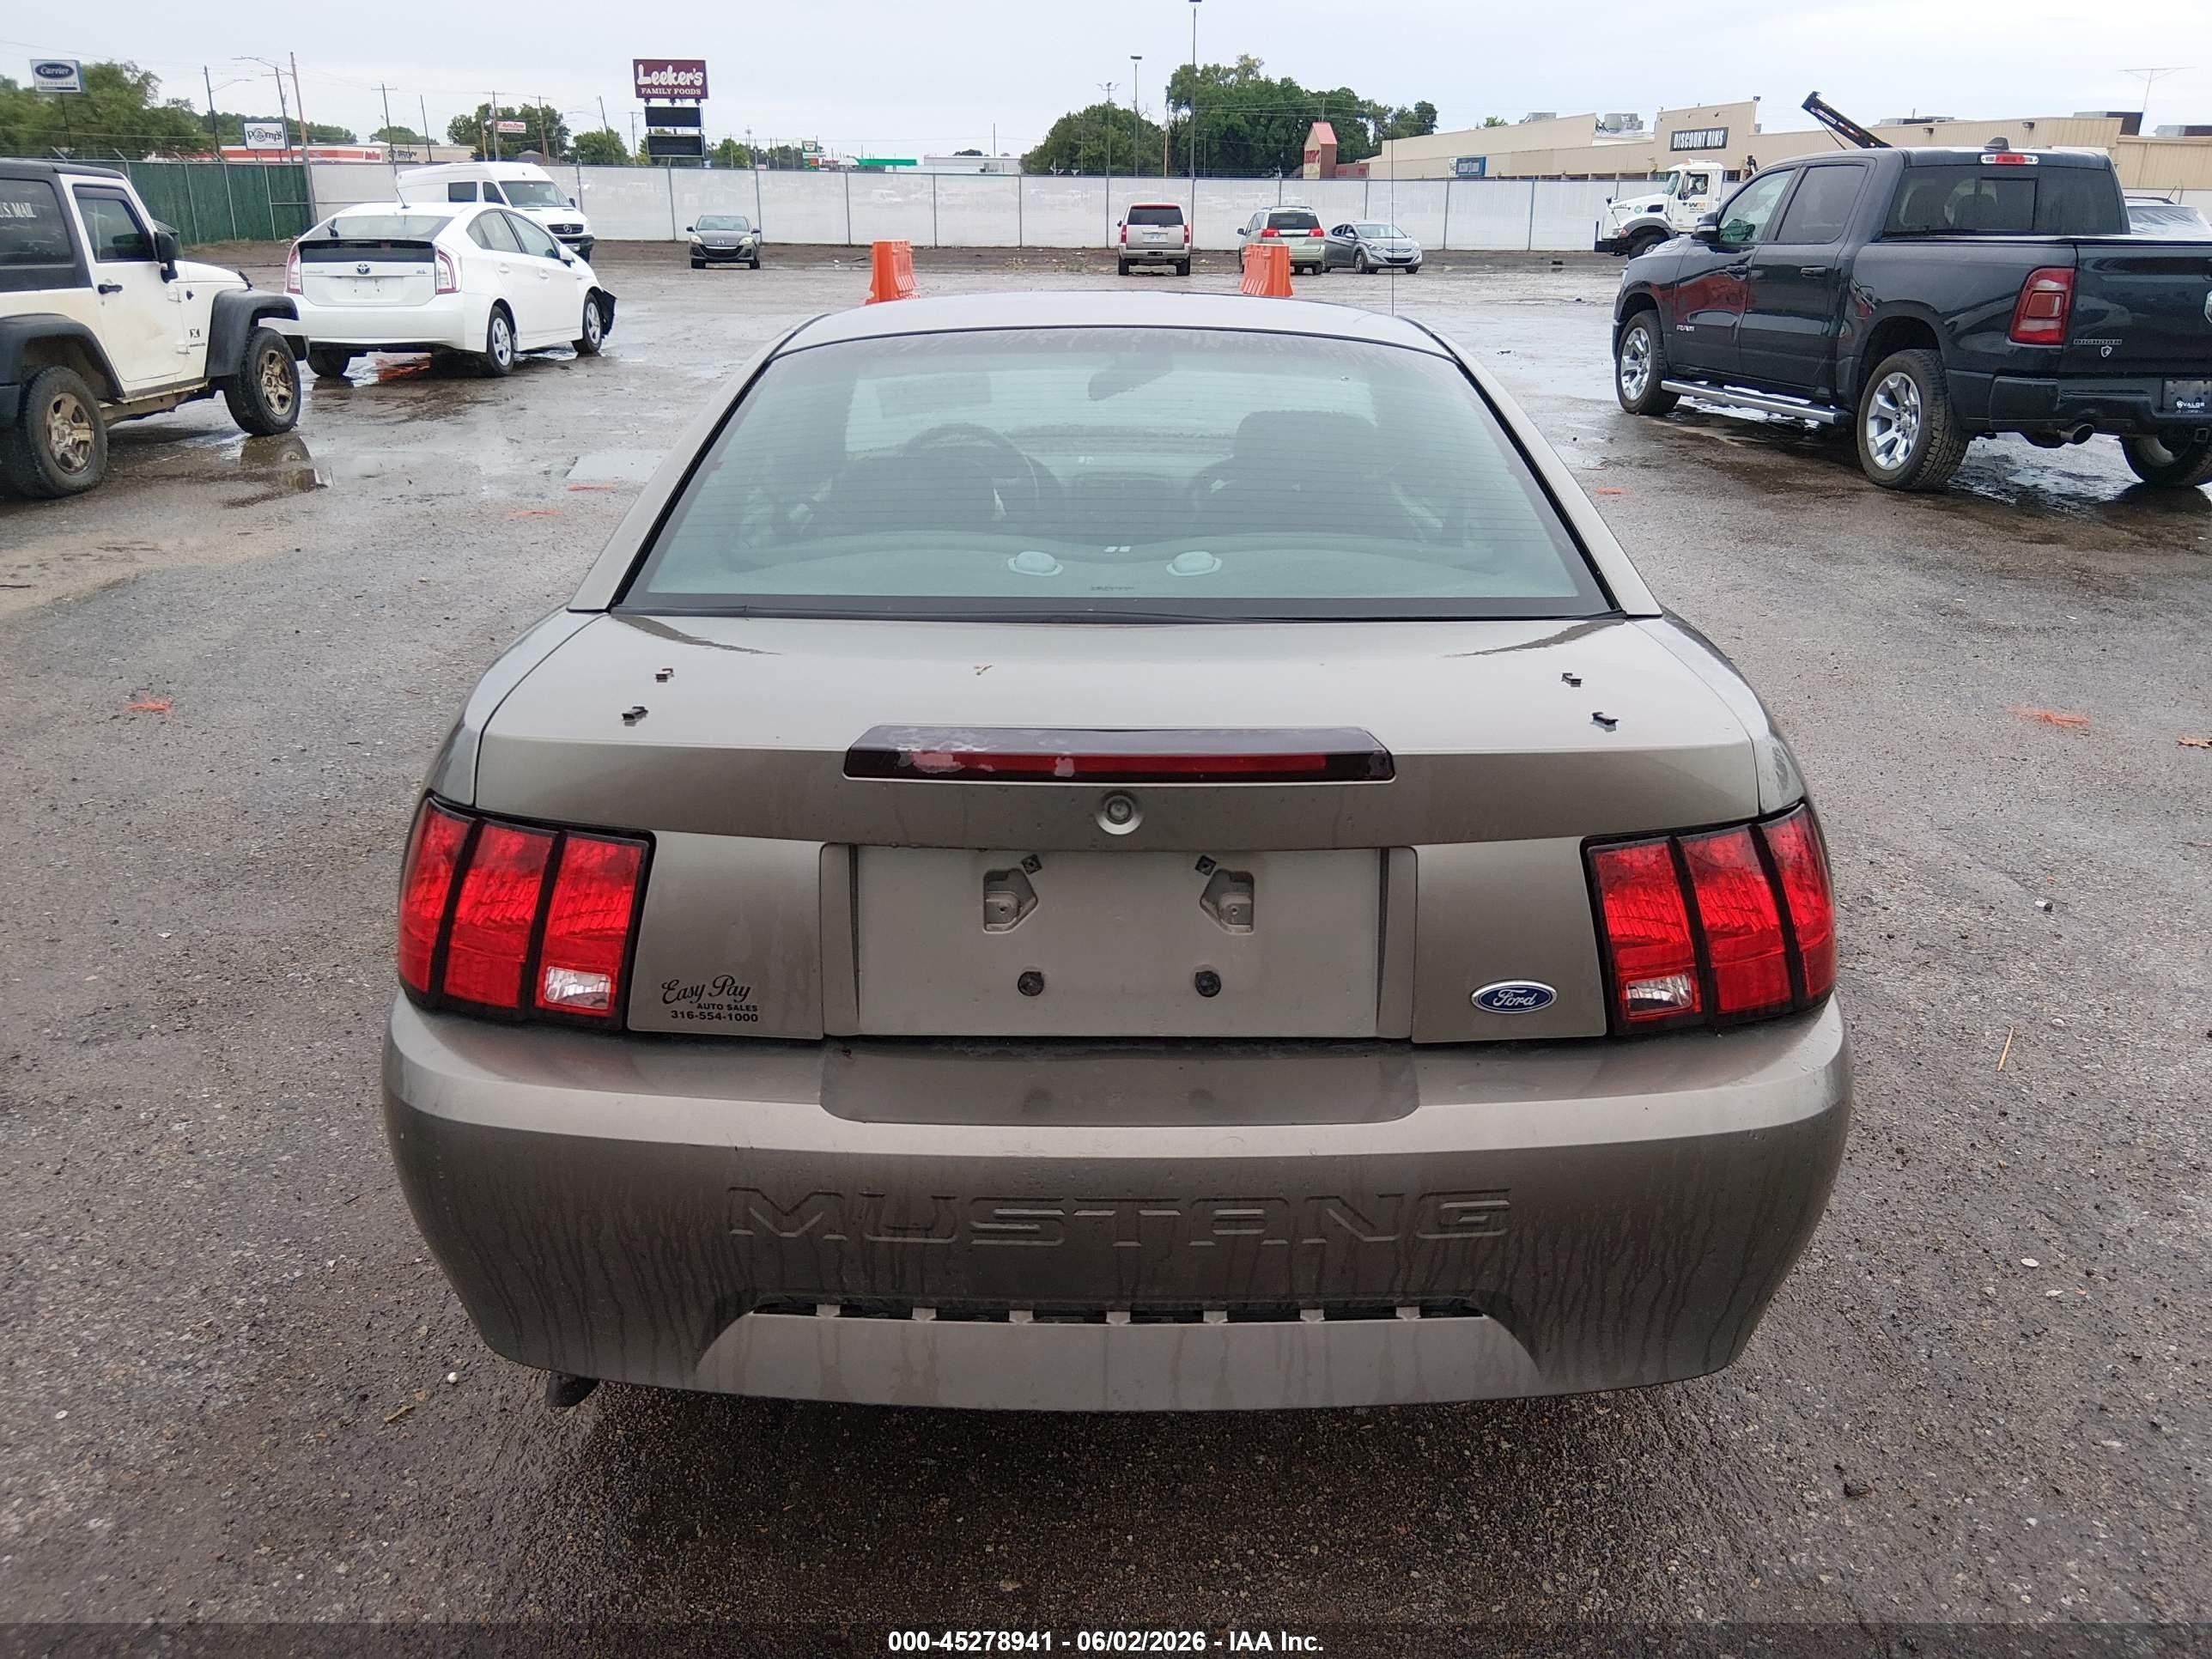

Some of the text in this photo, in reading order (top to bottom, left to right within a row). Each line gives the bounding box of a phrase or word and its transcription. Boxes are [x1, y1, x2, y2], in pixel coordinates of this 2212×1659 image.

[40, 65, 70, 75] Carrier
[637, 64, 704, 86] Leeker's
[1673, 130, 1724, 149] DISCOUNT BINS
[661, 975, 751, 1005] Easy Pay
[1492, 989, 1538, 1006] Ford
[671, 1010, 758, 1022] 316-554-1000
[727, 1187, 1511, 1247] MUSTANG
